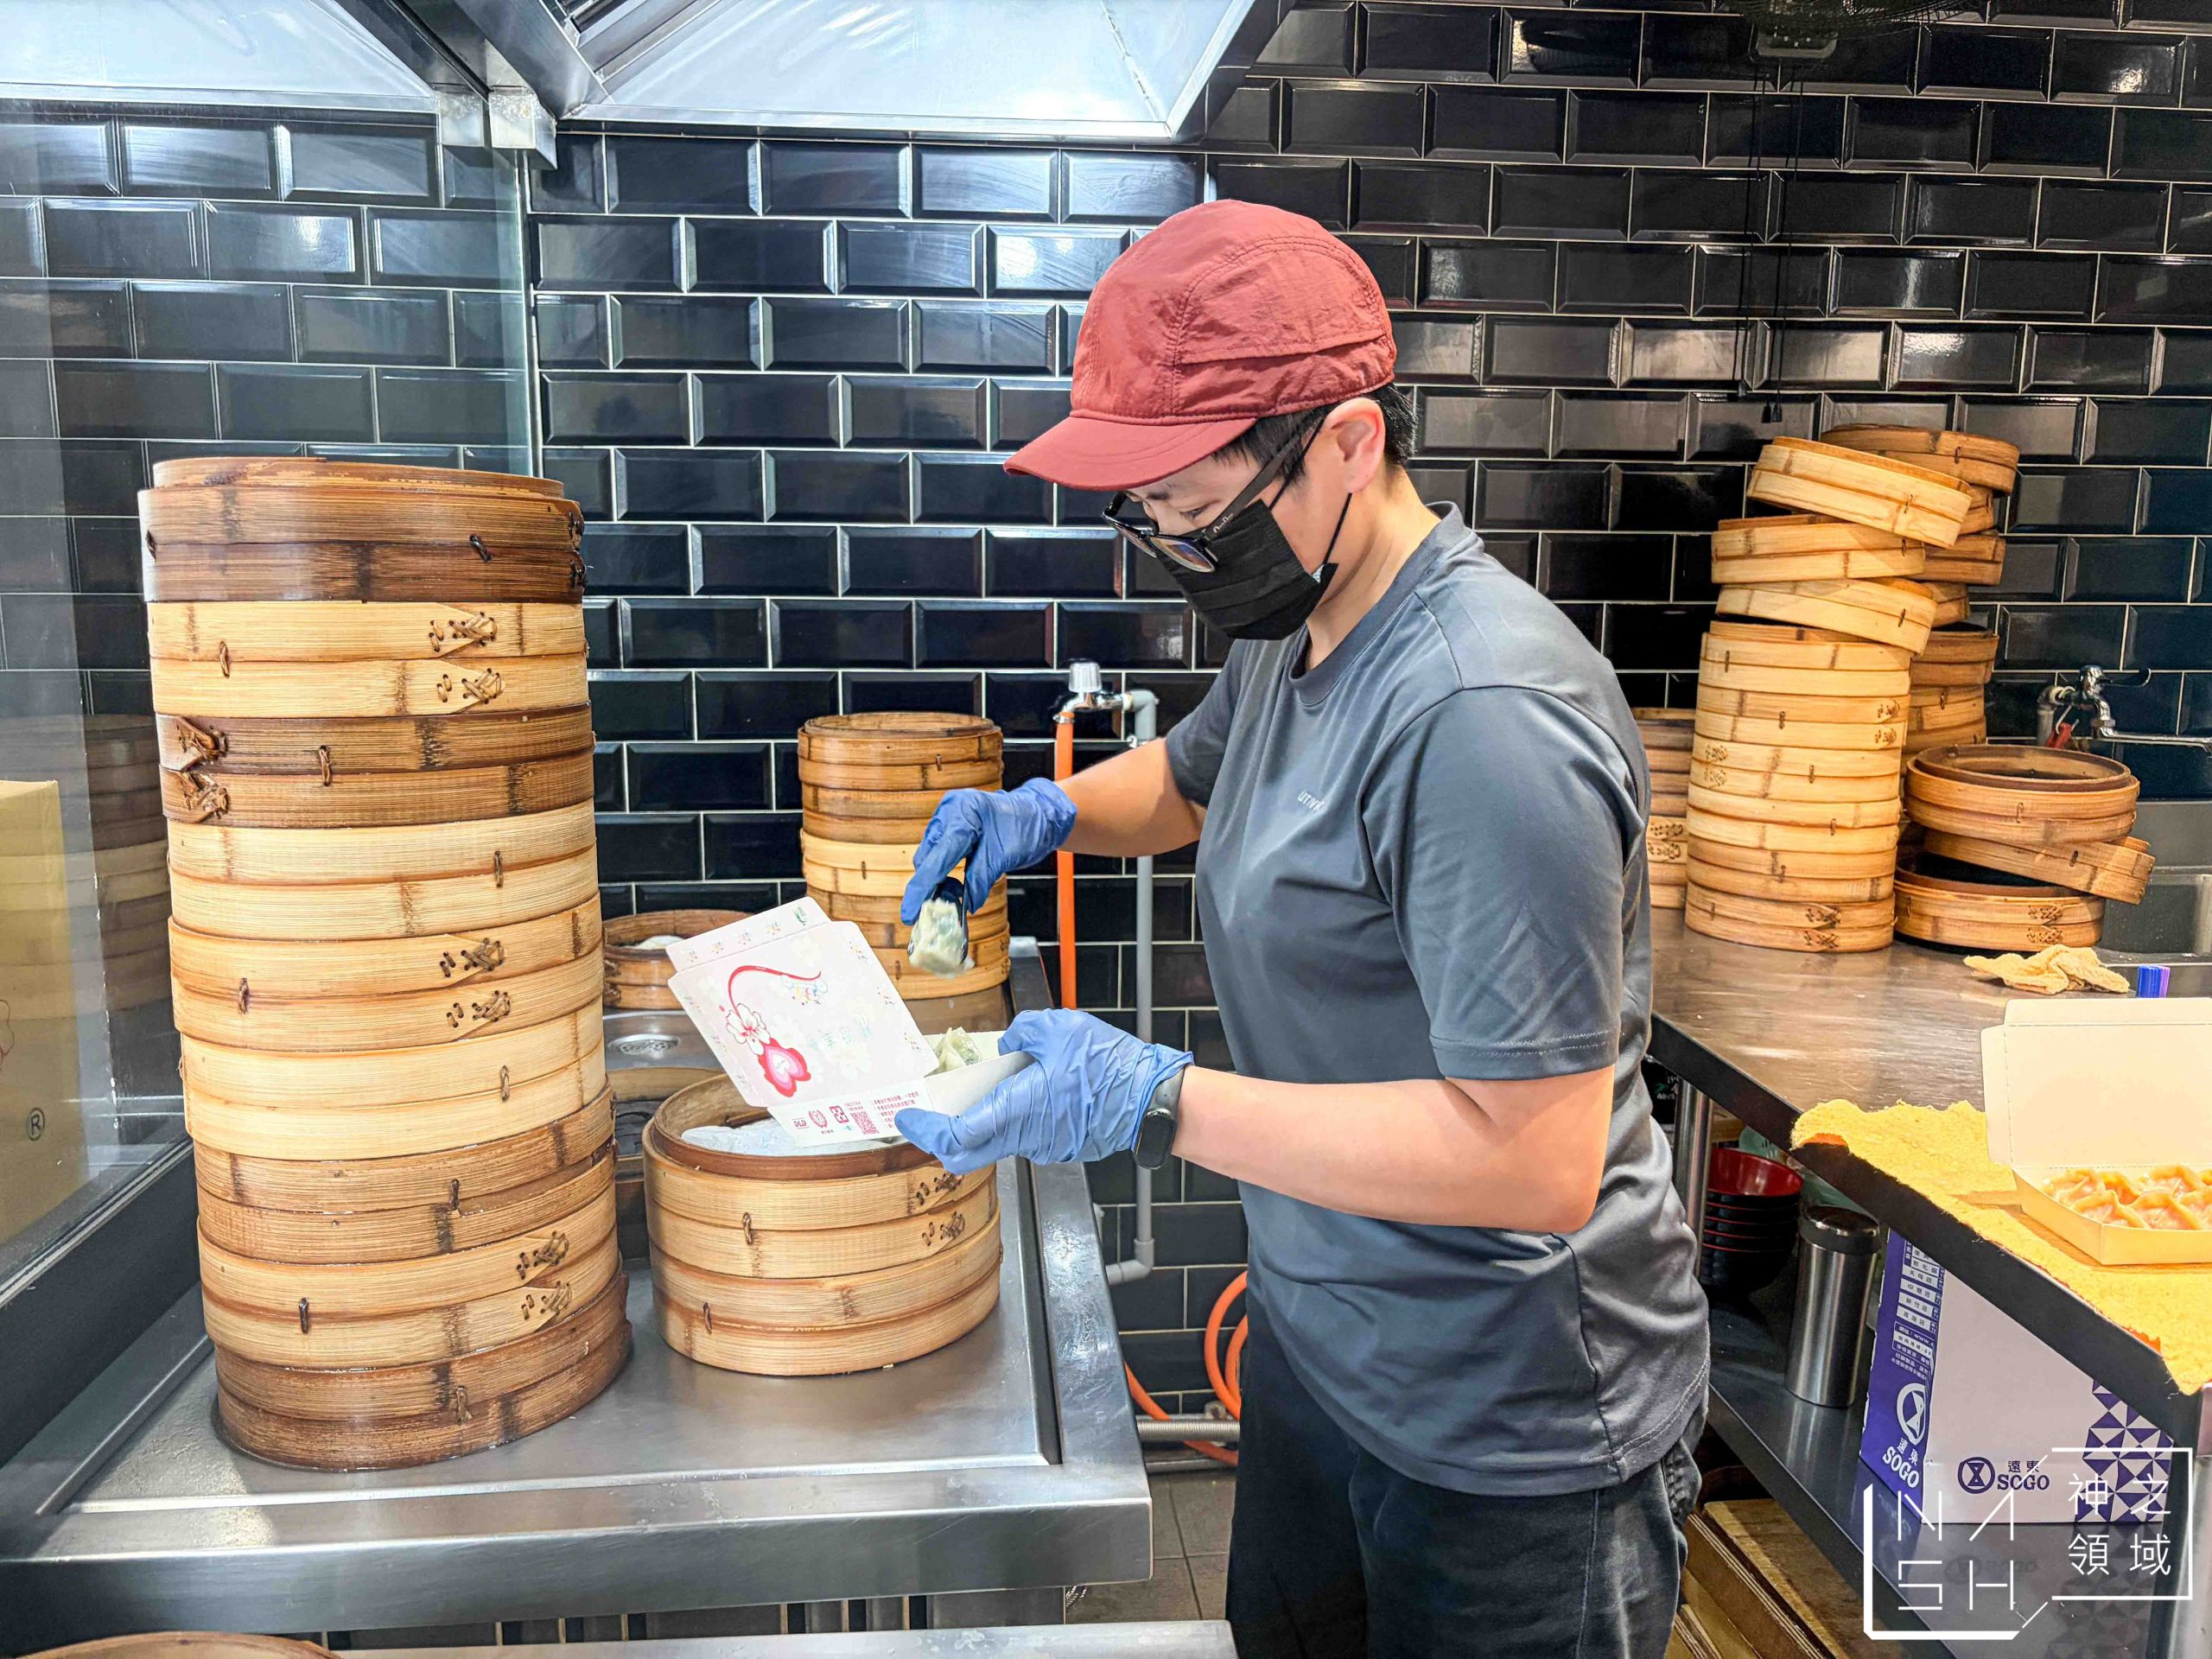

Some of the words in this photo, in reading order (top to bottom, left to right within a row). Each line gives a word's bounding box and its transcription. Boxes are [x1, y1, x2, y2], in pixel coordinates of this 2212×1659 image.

[1897, 1437, 1918, 1466] 遠東
[1882, 1446, 1919, 1488] SOGO
[2007, 1460, 2039, 1472] 遠東
[1997, 1474, 2050, 1491] SOGO
